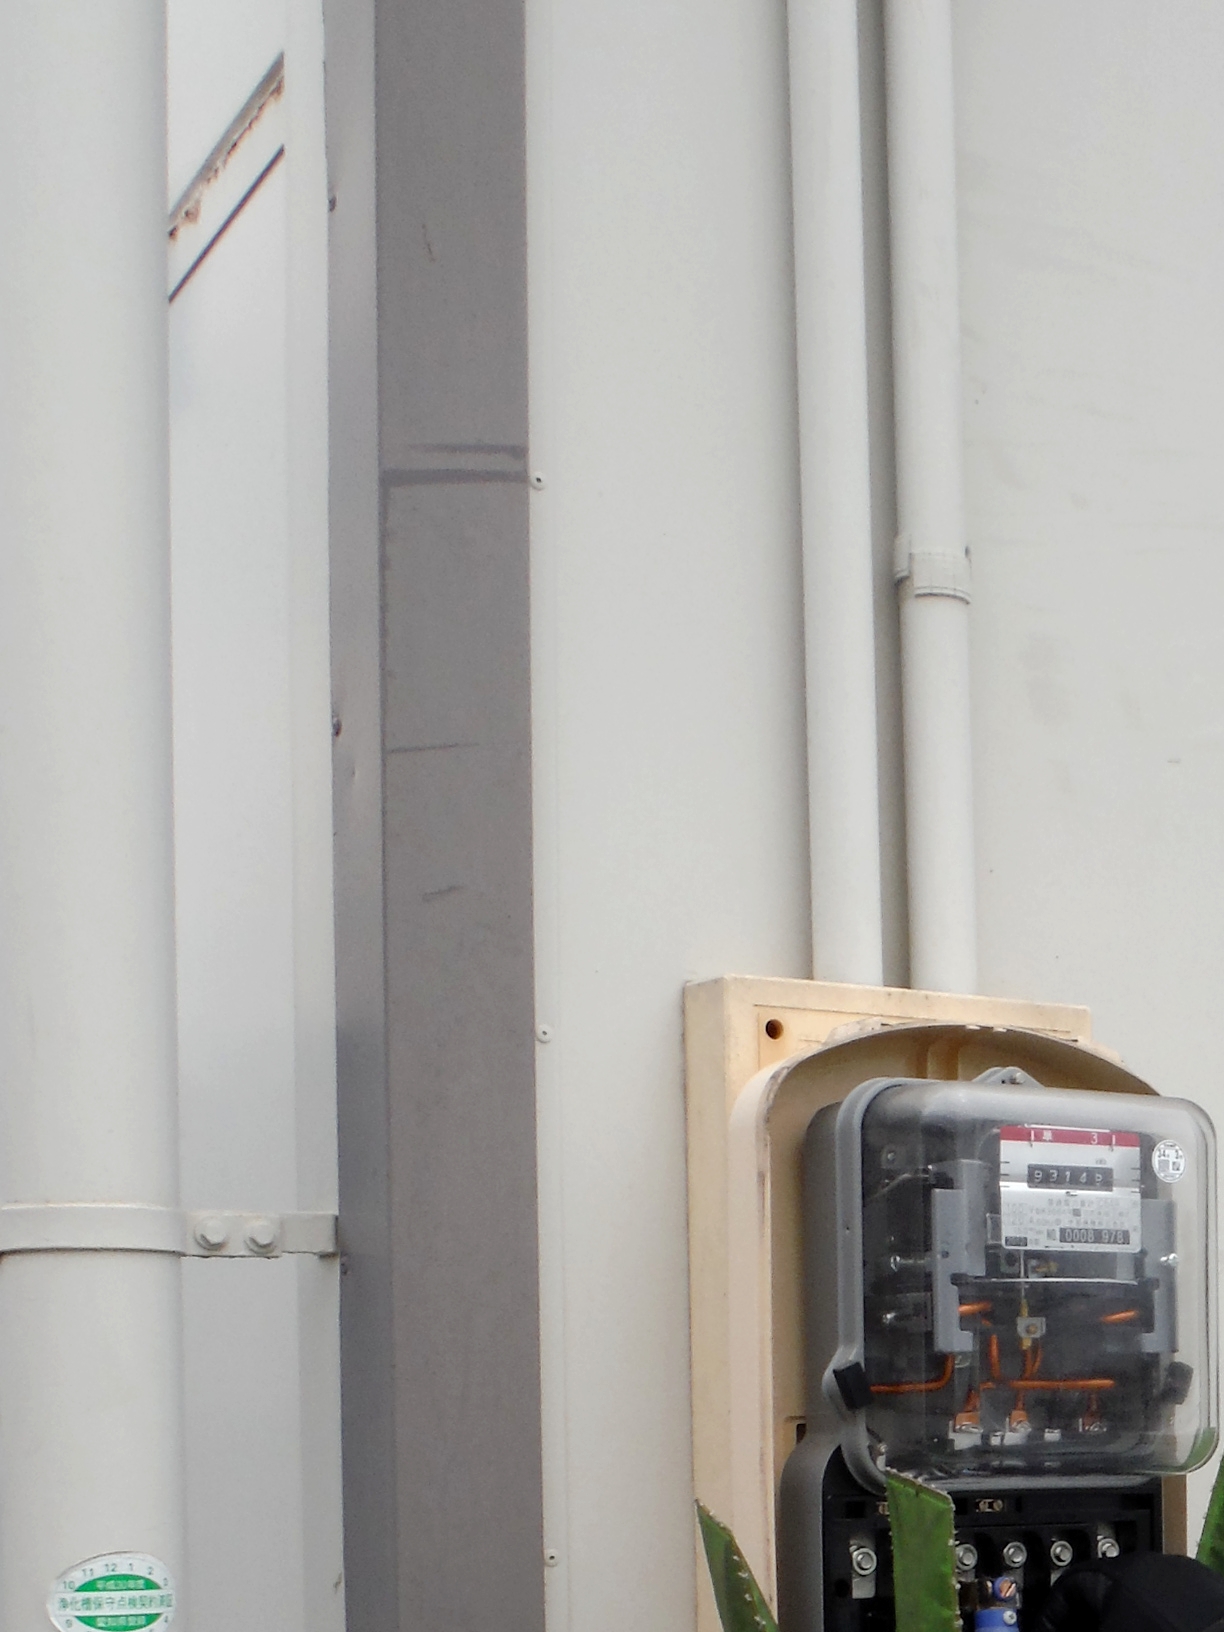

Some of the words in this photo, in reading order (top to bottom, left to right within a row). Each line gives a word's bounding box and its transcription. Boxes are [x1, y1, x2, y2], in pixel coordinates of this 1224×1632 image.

[1091, 1132, 1098, 1145] 3
[1065, 1229, 1095, 1243] 0008
[1101, 1230, 1124, 1244] 978
[82, 1568, 94, 1577] 11
[105, 1563, 118, 1573] 12
[63, 1580, 75, 1590] 10
